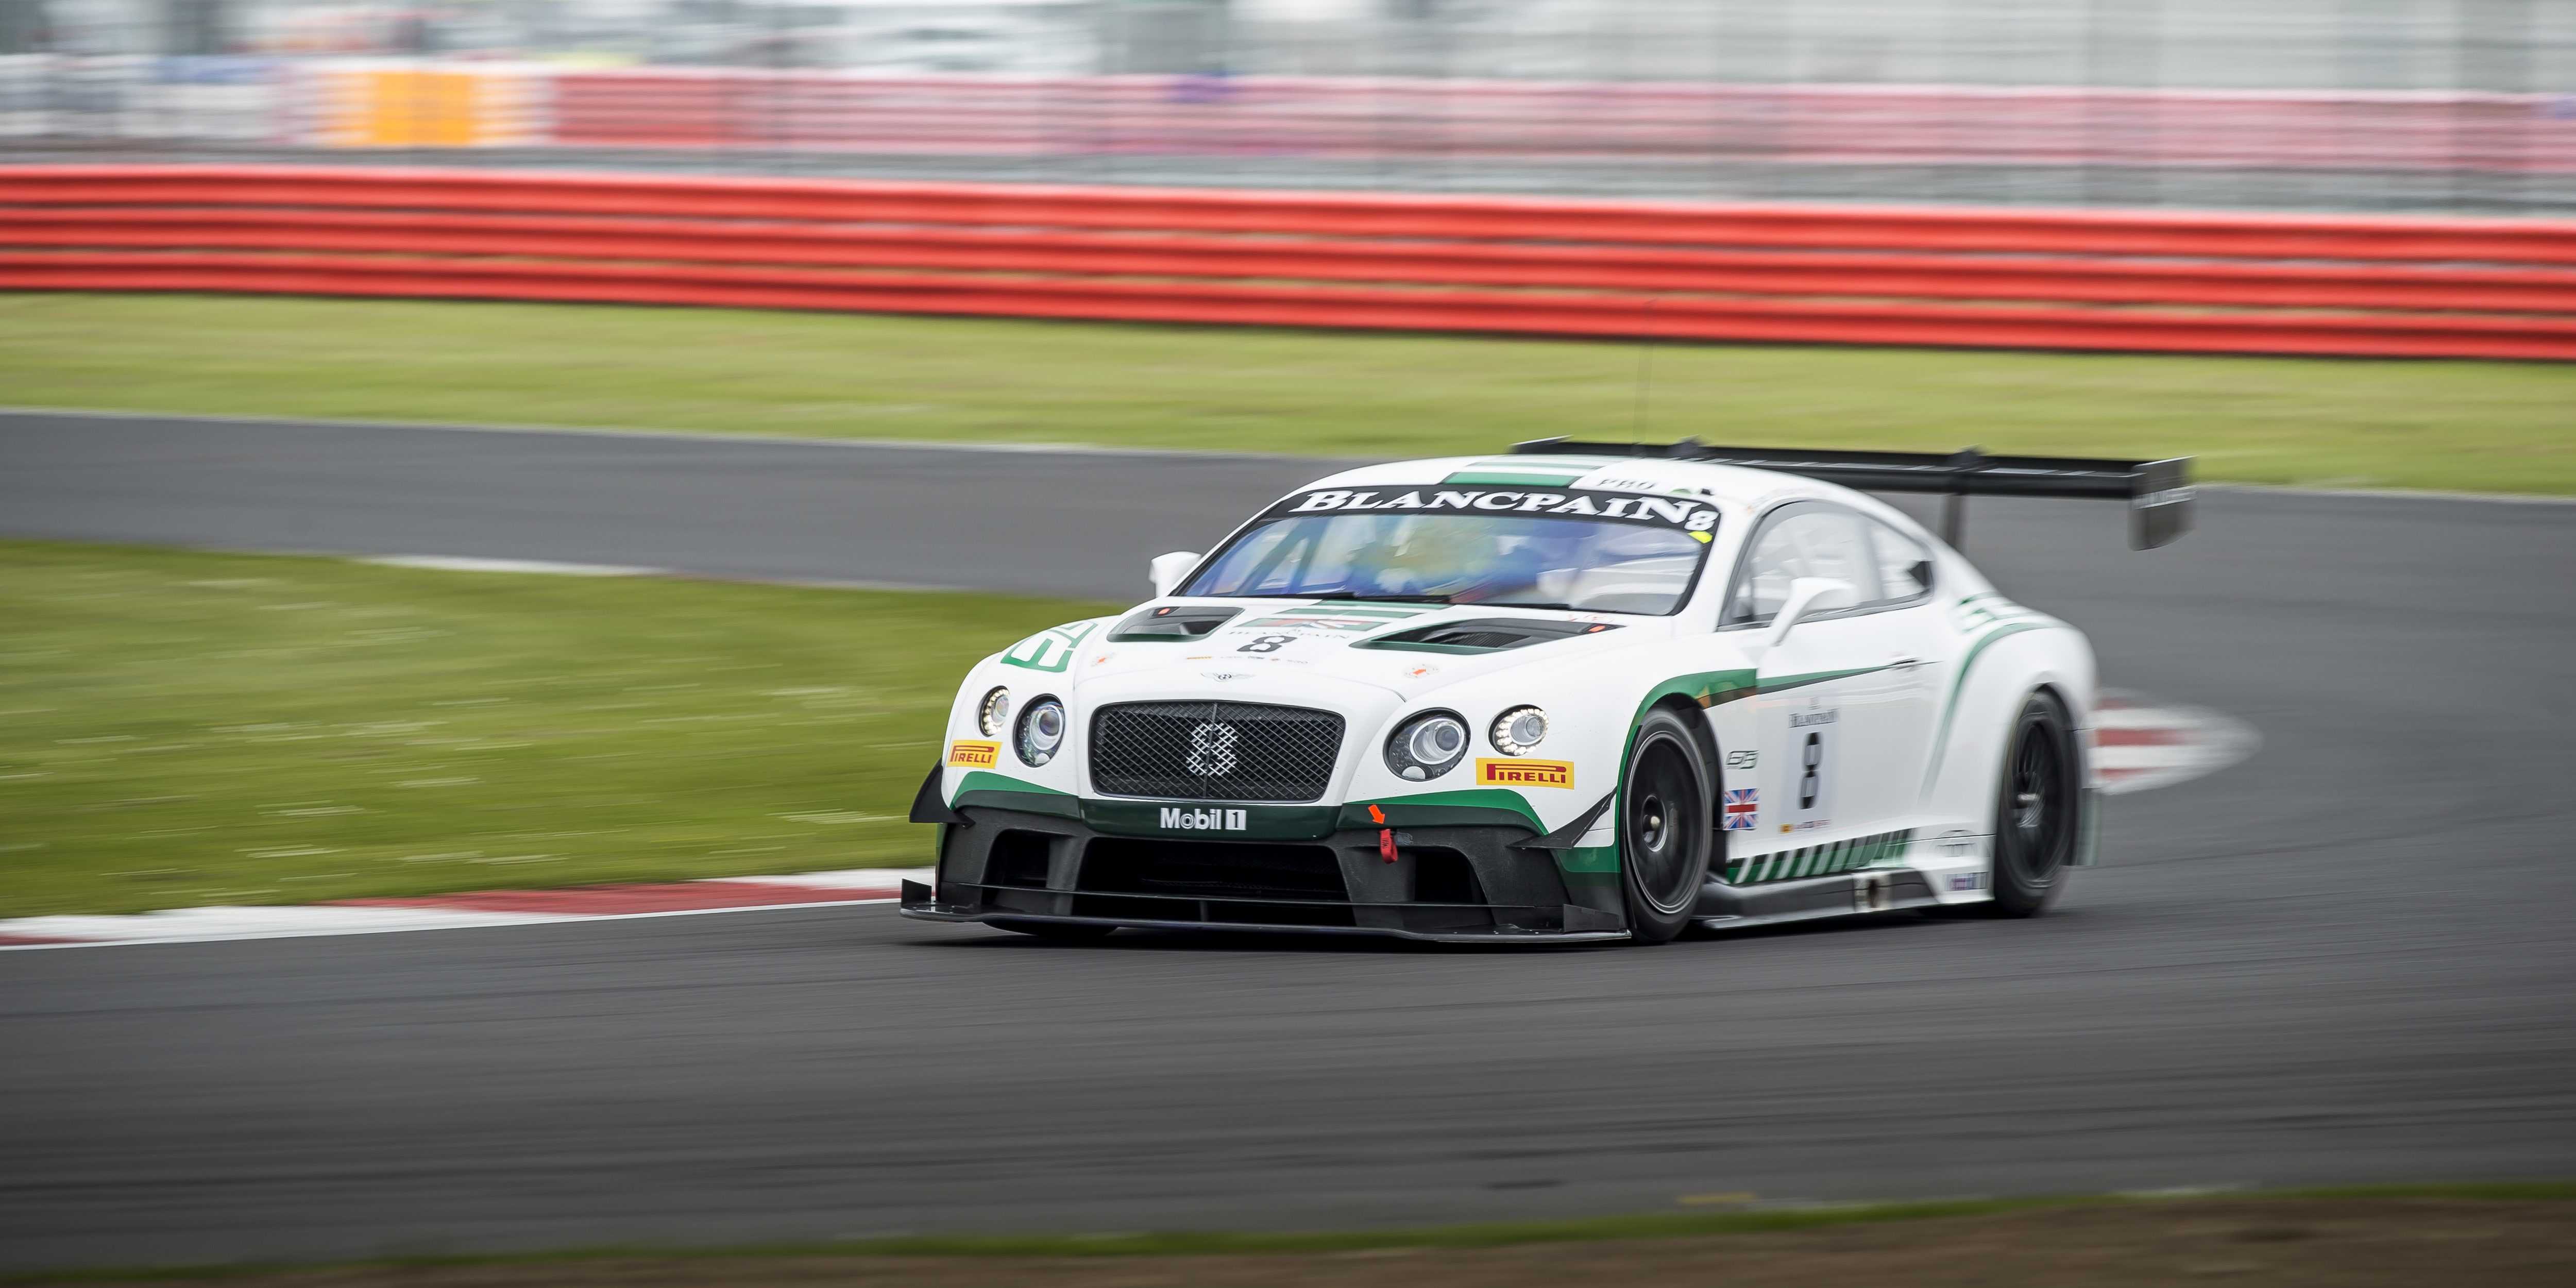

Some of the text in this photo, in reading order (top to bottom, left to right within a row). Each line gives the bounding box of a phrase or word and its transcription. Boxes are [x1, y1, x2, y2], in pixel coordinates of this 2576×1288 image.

[1288, 490, 1702, 523] BLANCPAIN
[1684, 511, 1720, 531] 8
[1236, 635, 1298, 652] 8
[950, 745, 994, 764] PIRELLI
[1186, 723, 1237, 776] 8
[1487, 764, 1567, 784] PIRELLI
[1798, 731, 1824, 809] 8
[1160, 807, 1222, 829] Mobil
